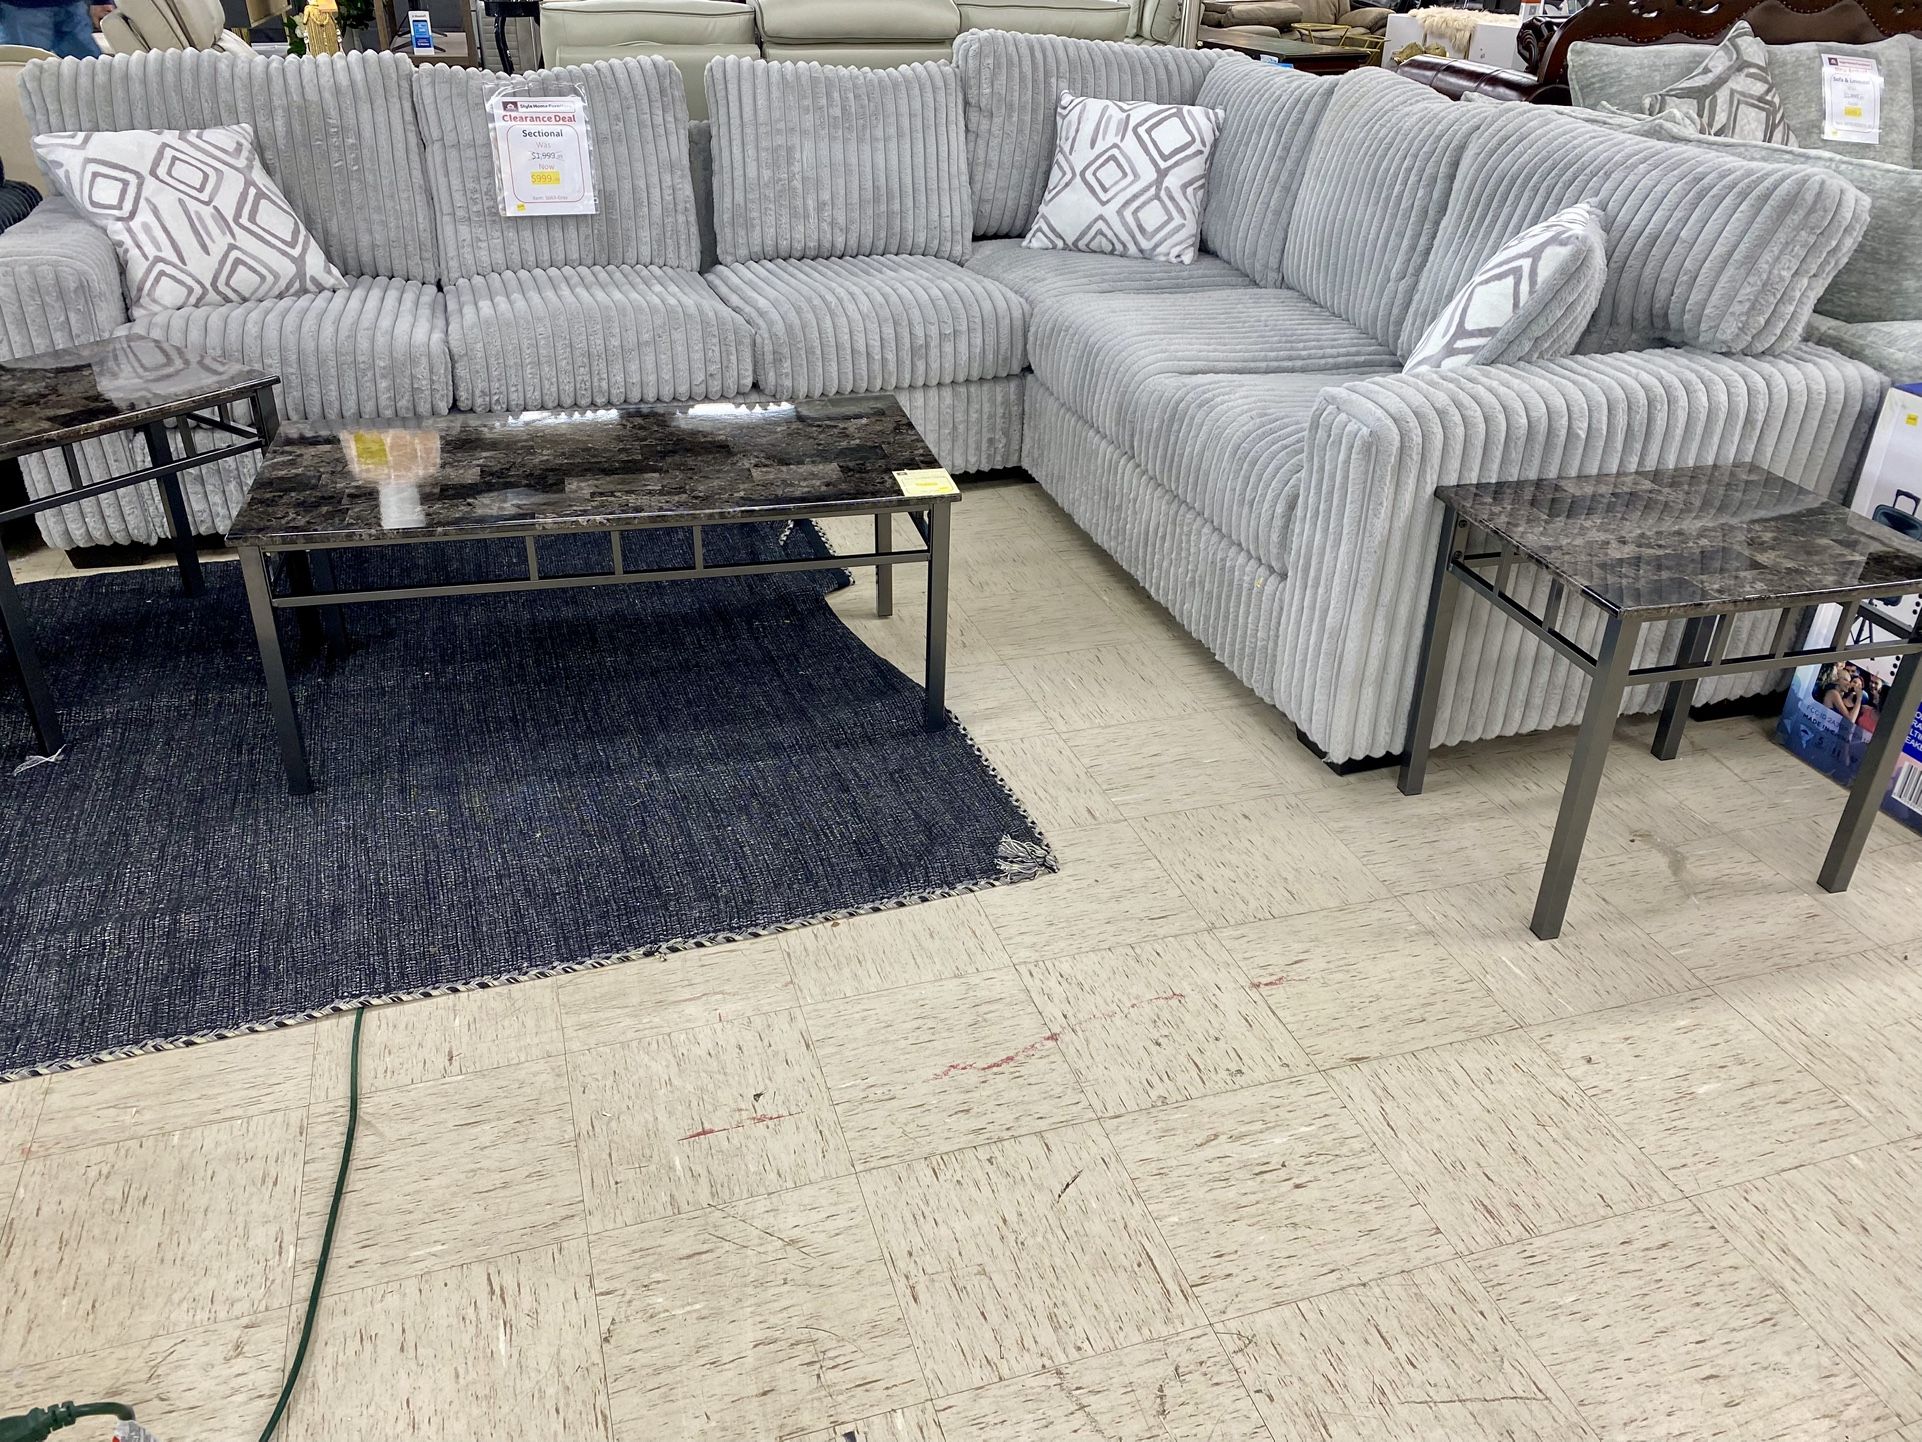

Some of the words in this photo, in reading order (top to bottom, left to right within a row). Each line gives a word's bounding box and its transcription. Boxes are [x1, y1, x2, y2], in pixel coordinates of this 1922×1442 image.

[502, 114, 553, 122] Clearance
[554, 114, 577, 123] Deal
[522, 129, 563, 138] Sectional
[1803, 713, 1822, 727] MADE
